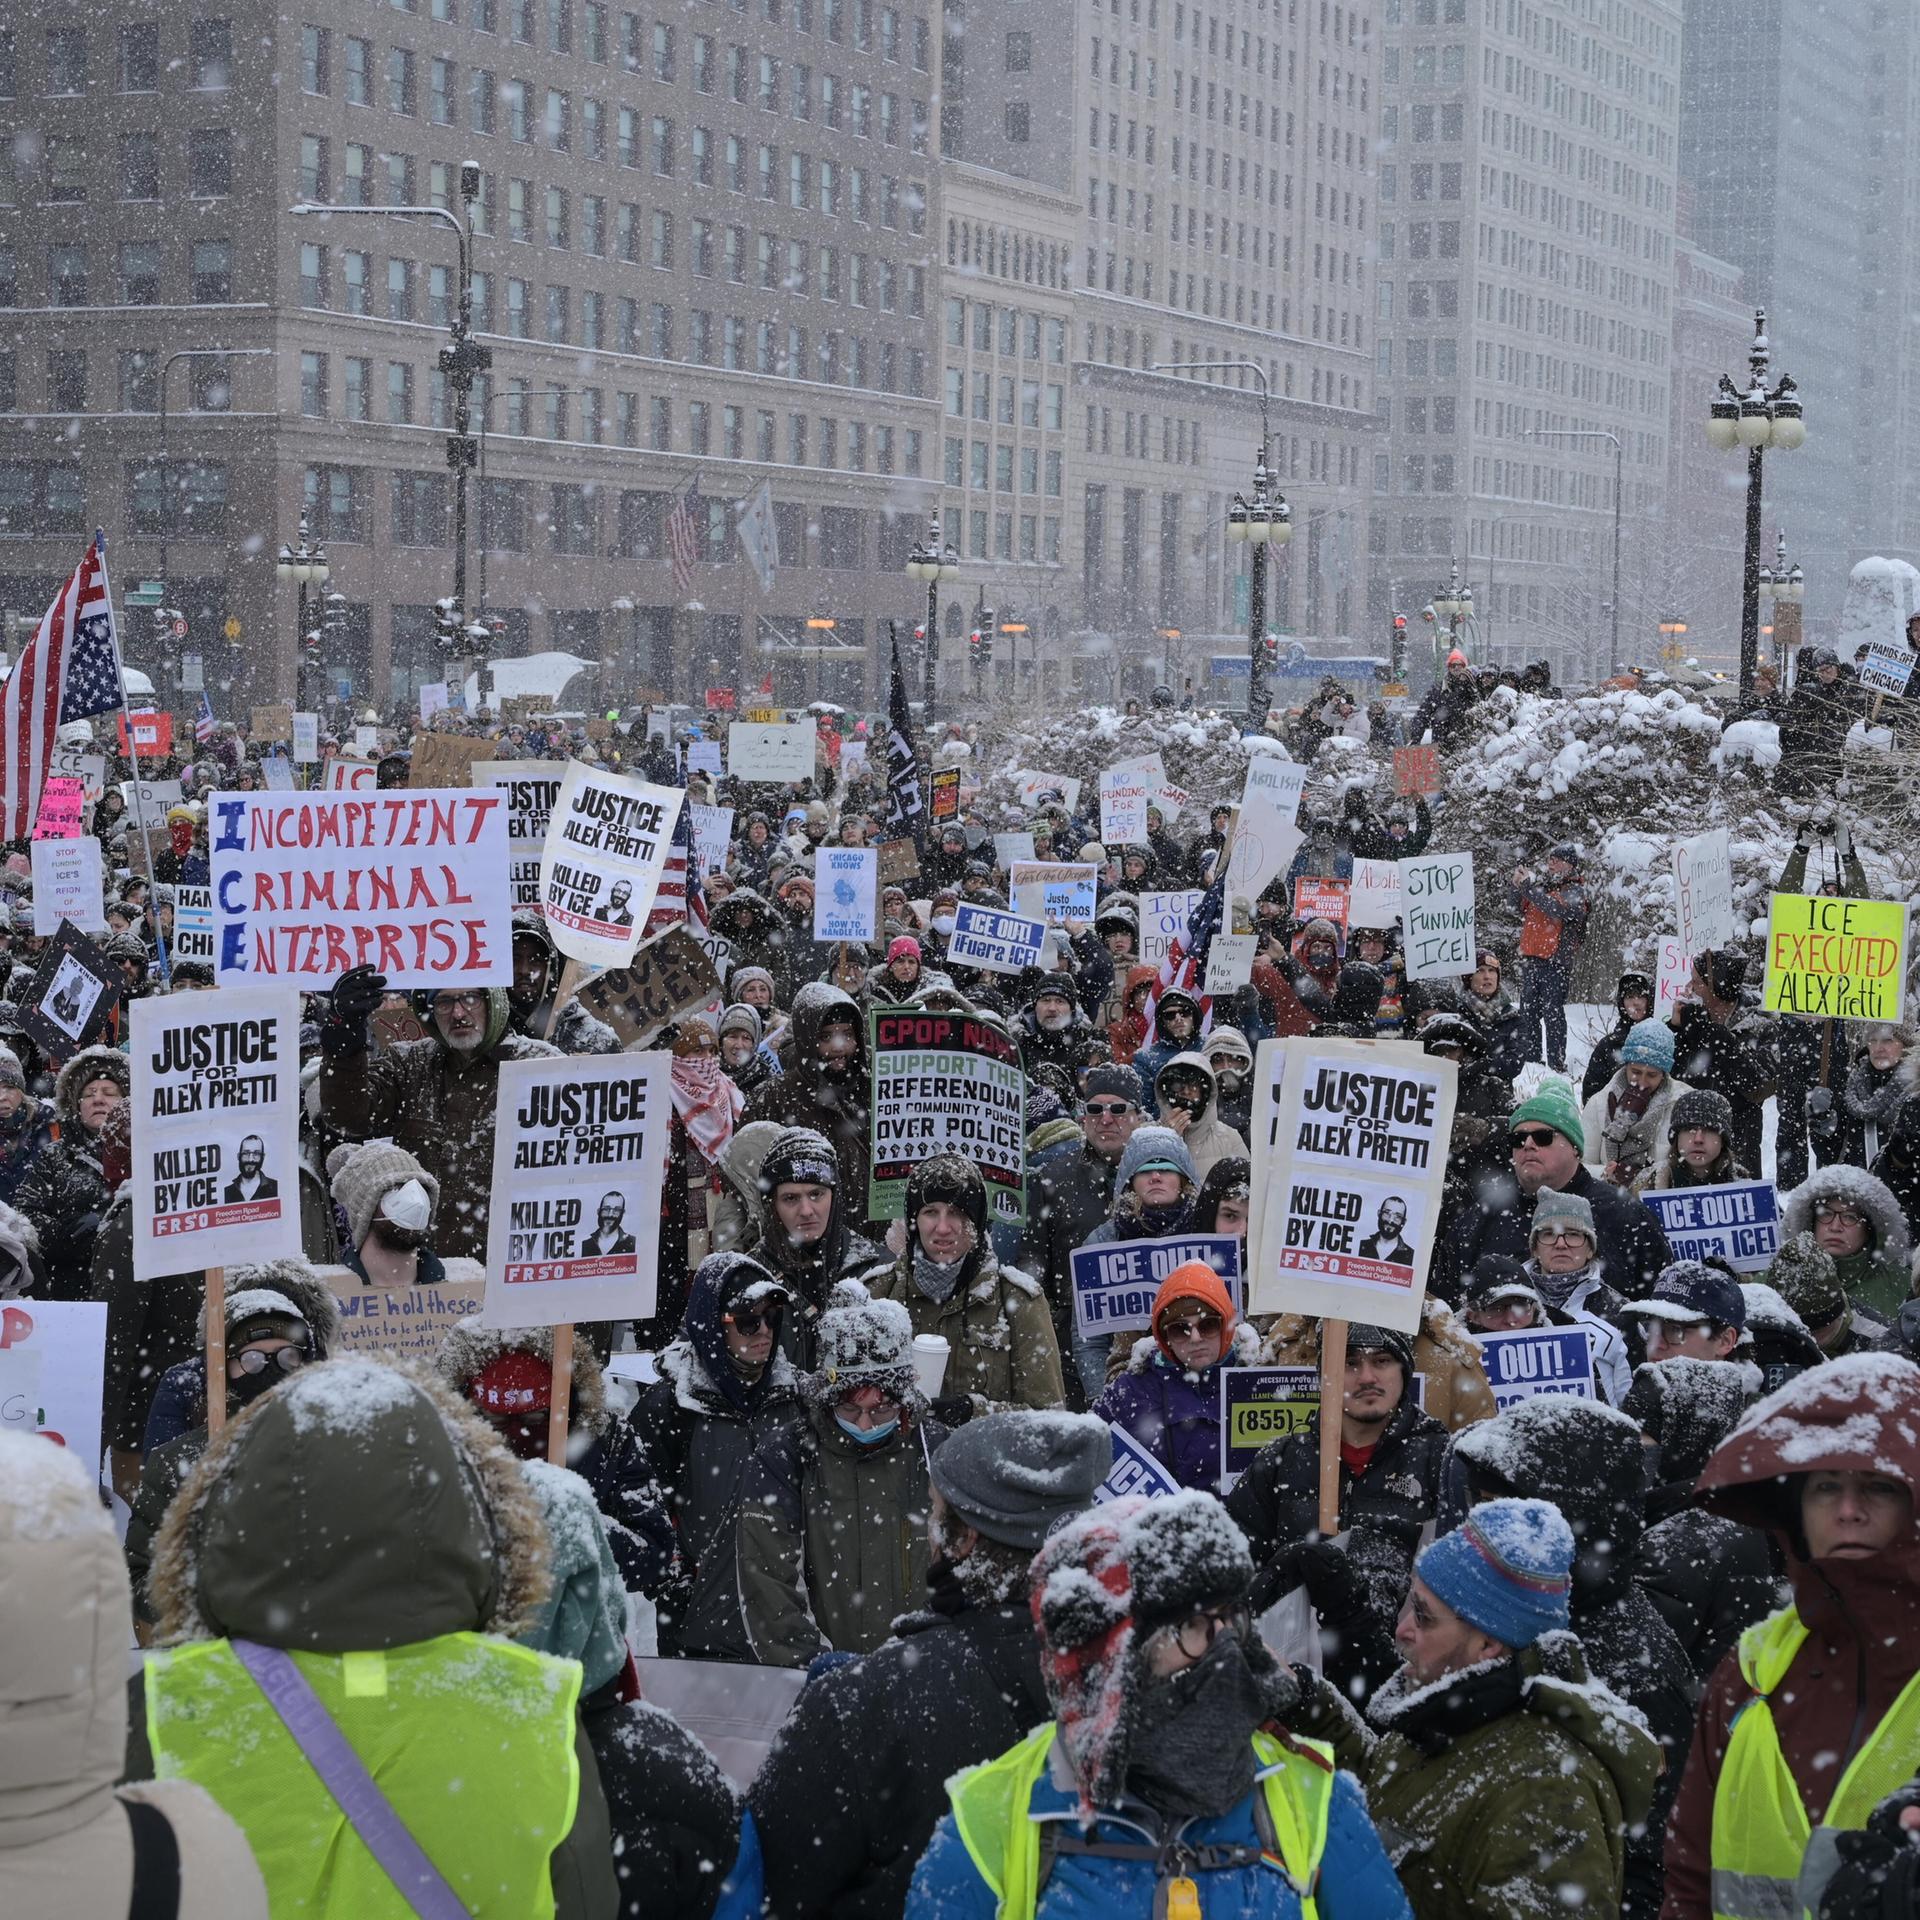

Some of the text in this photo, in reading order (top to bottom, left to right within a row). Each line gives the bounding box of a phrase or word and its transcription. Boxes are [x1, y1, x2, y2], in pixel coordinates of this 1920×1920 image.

[1871, 641, 1915, 666] HANDS OFF
[1862, 669, 1905, 694] CHICAGO
[1102, 786, 1145, 801] FUNDING
[1113, 773, 1130, 787] NO
[572, 786, 664, 834] JUSTICE
[1112, 800, 1134, 812] FOR
[214, 798, 499, 852] INCOMPETENT
[599, 821, 631, 835] FOR
[56, 849, 77, 857] STOP
[562, 819, 602, 850] ALEX
[603, 831, 656, 862] PRETTI
[51, 860, 82, 868] FUNDING
[828, 853, 864, 862] CHICAGO
[831, 862, 861, 870] KNOWS
[56, 871, 80, 880] ICE'S
[551, 862, 602, 894] KILLED
[1408, 864, 1464, 896] STOP
[56, 887, 81, 895] REIGN
[218, 865, 473, 914] CRIMINAL
[549, 889, 595, 916] BY ICE
[1301, 885, 1320, 895] STOP
[54, 910, 86, 918] TERROR
[1060, 905, 1090, 916] TODOS
[1300, 909, 1344, 917] IMMIGRANTS
[1316, 902, 1344, 910] DEFEND
[1808, 899, 1857, 935] ICE
[821, 928, 867, 937] HANDLE ICE
[828, 920, 848, 928] HOW
[969, 911, 1032, 944] ICE OUT!
[220, 918, 492, 974] ENTERPRISE
[1008, 946, 1037, 967] ICE!
[1416, 938, 1470, 970] ICE!
[1775, 933, 1898, 977] EXECUTED
[69, 958, 97, 985] NO KINGS
[1210, 965, 1232, 977] Alex
[624, 970, 693, 1028] ICE
[1212, 980, 1234, 991] Pretti
[1778, 972, 1833, 1014] ALEX
[879, 1019, 950, 1044] CPOP
[152, 1018, 277, 1074] JUSTICE
[192, 1066, 237, 1081] FOR
[877, 1054, 1020, 1091] SUPPORT THE
[152, 1074, 277, 1117] ALEX PRETTI
[518, 1078, 648, 1129] JUSTICE
[877, 1078, 1021, 1114] REFERENDUM
[1304, 1068, 1437, 1128] JUSTICE
[877, 1102, 1021, 1130] FOR COMMUNITY POWER
[1343, 1115, 1390, 1133] FOR
[559, 1124, 606, 1139] FOR
[877, 1117, 1021, 1152] OVER POLICE
[514, 1132, 644, 1169] ALEX PRETTI
[1297, 1122, 1430, 1169] ALEX PRETTI
[154, 1144, 221, 1181] KILLED
[983, 1166, 1022, 1187] PEOPLE
[155, 1177, 218, 1214] BY ICE
[1290, 1185, 1363, 1222] KILLED
[215, 1205, 260, 1218] Freedom Road
[215, 1211, 279, 1225] Socialist Organization
[510, 1198, 582, 1230] KILLED
[1661, 1192, 1756, 1229] ICE OUT!
[508, 1230, 575, 1262] BY ICE
[1285, 1217, 1354, 1254] BY ICE
[1731, 1226, 1777, 1257] ICE!
[571, 1259, 616, 1271] Freedom Road
[571, 1263, 636, 1278] Socialist Organization
[1100, 1251, 1143, 1285] ICE
[1346, 1261, 1393, 1275] Freedom Road
[1346, 1268, 1411, 1285] Socialist Organization
[338, 1290, 477, 1318] WE hold these
[340, 1325, 380, 1341] ruths
[383, 1321, 397, 1336] to
[1498, 1340, 1564, 1380] OUT!
[1290, 1376, 1311, 1384] APOYO
[1106, 1452, 1156, 1500] ICE
